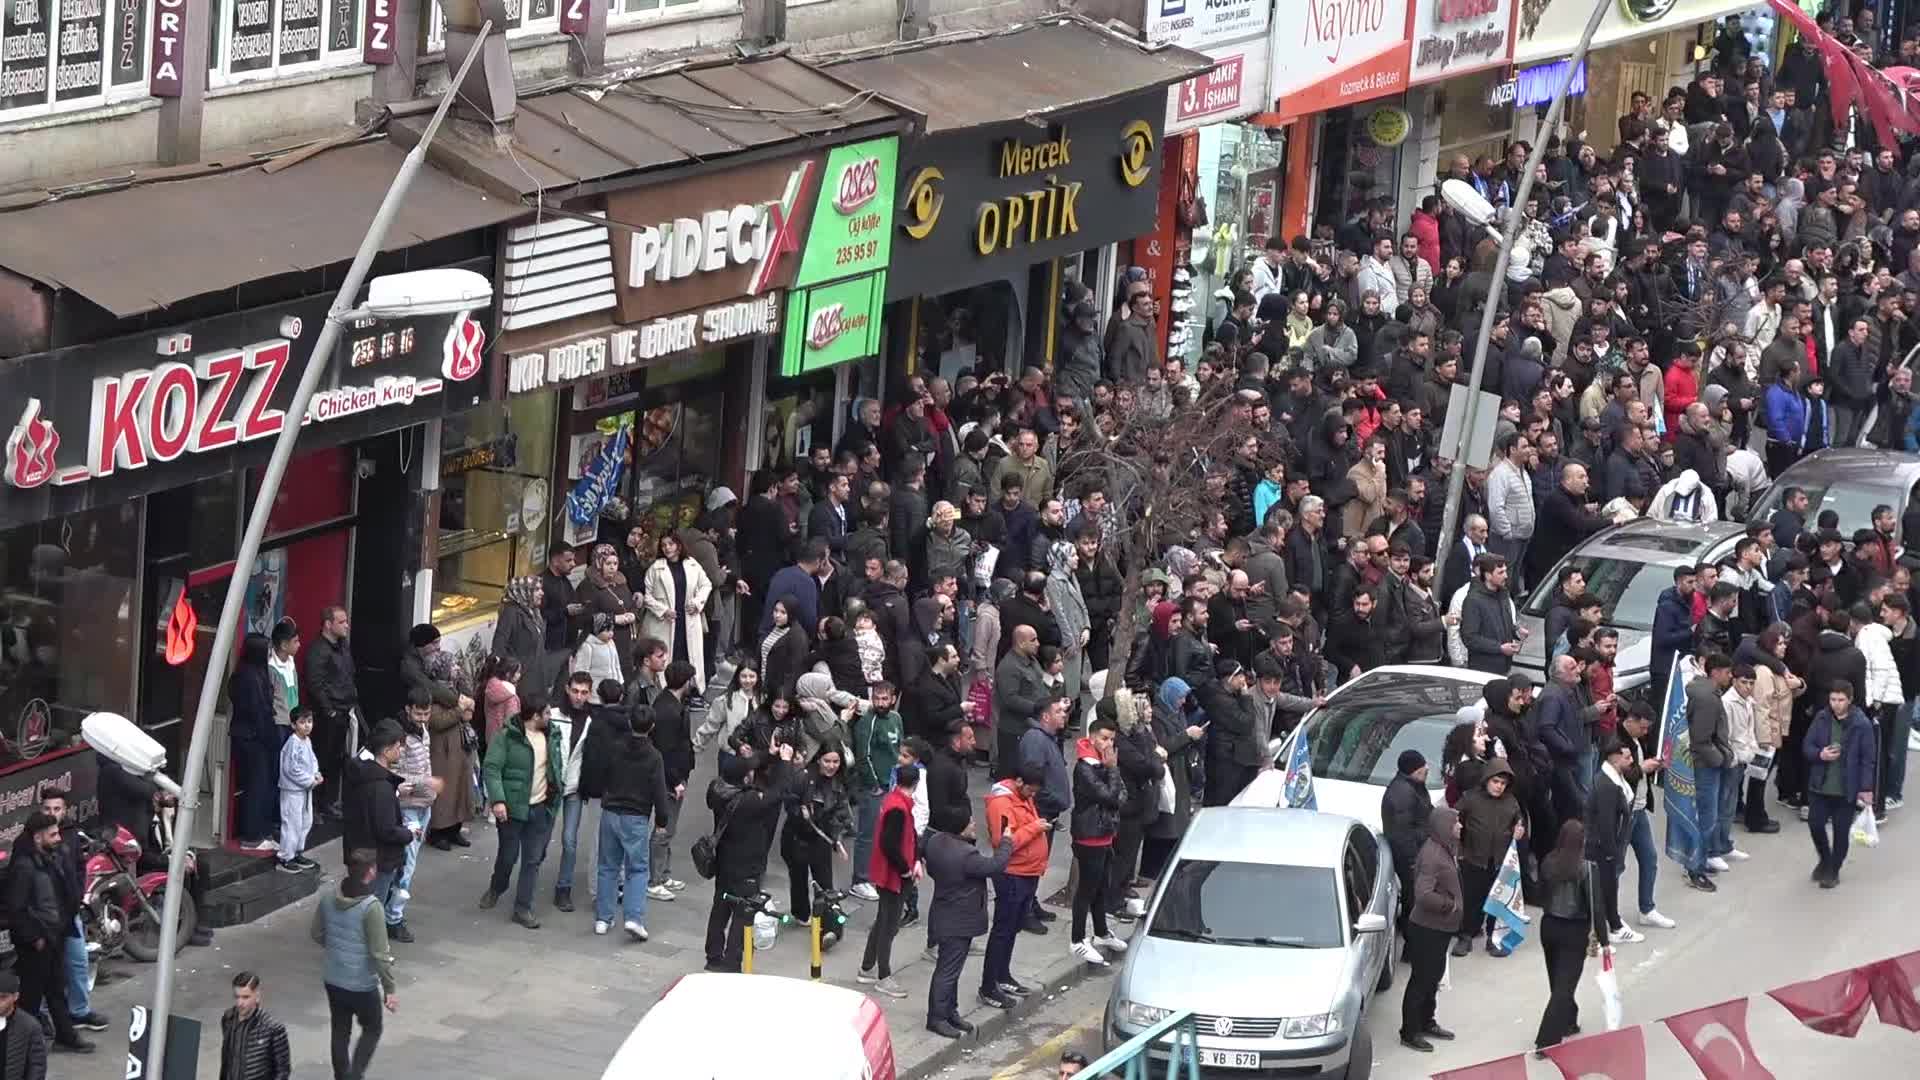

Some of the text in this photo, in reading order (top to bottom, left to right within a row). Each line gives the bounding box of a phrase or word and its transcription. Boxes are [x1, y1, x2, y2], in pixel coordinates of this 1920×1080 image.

[1208, 62, 1238, 85] VAKIF
[1203, 84, 1238, 112] İŞHANI
[1000, 124, 1072, 179] Mercek
[978, 174, 1083, 255] OPTİK
[835, 239, 878, 266] 235 95 97
[509, 353, 545, 394] KIR
[547, 337, 608, 384] PİDESİ
[611, 329, 638, 366] VE
[640, 313, 698, 359] BÖREK
[703, 299, 769, 343] SALONU
[317, 384, 414, 418] Chicken King
[1235, 1053, 1257, 1066] 678
